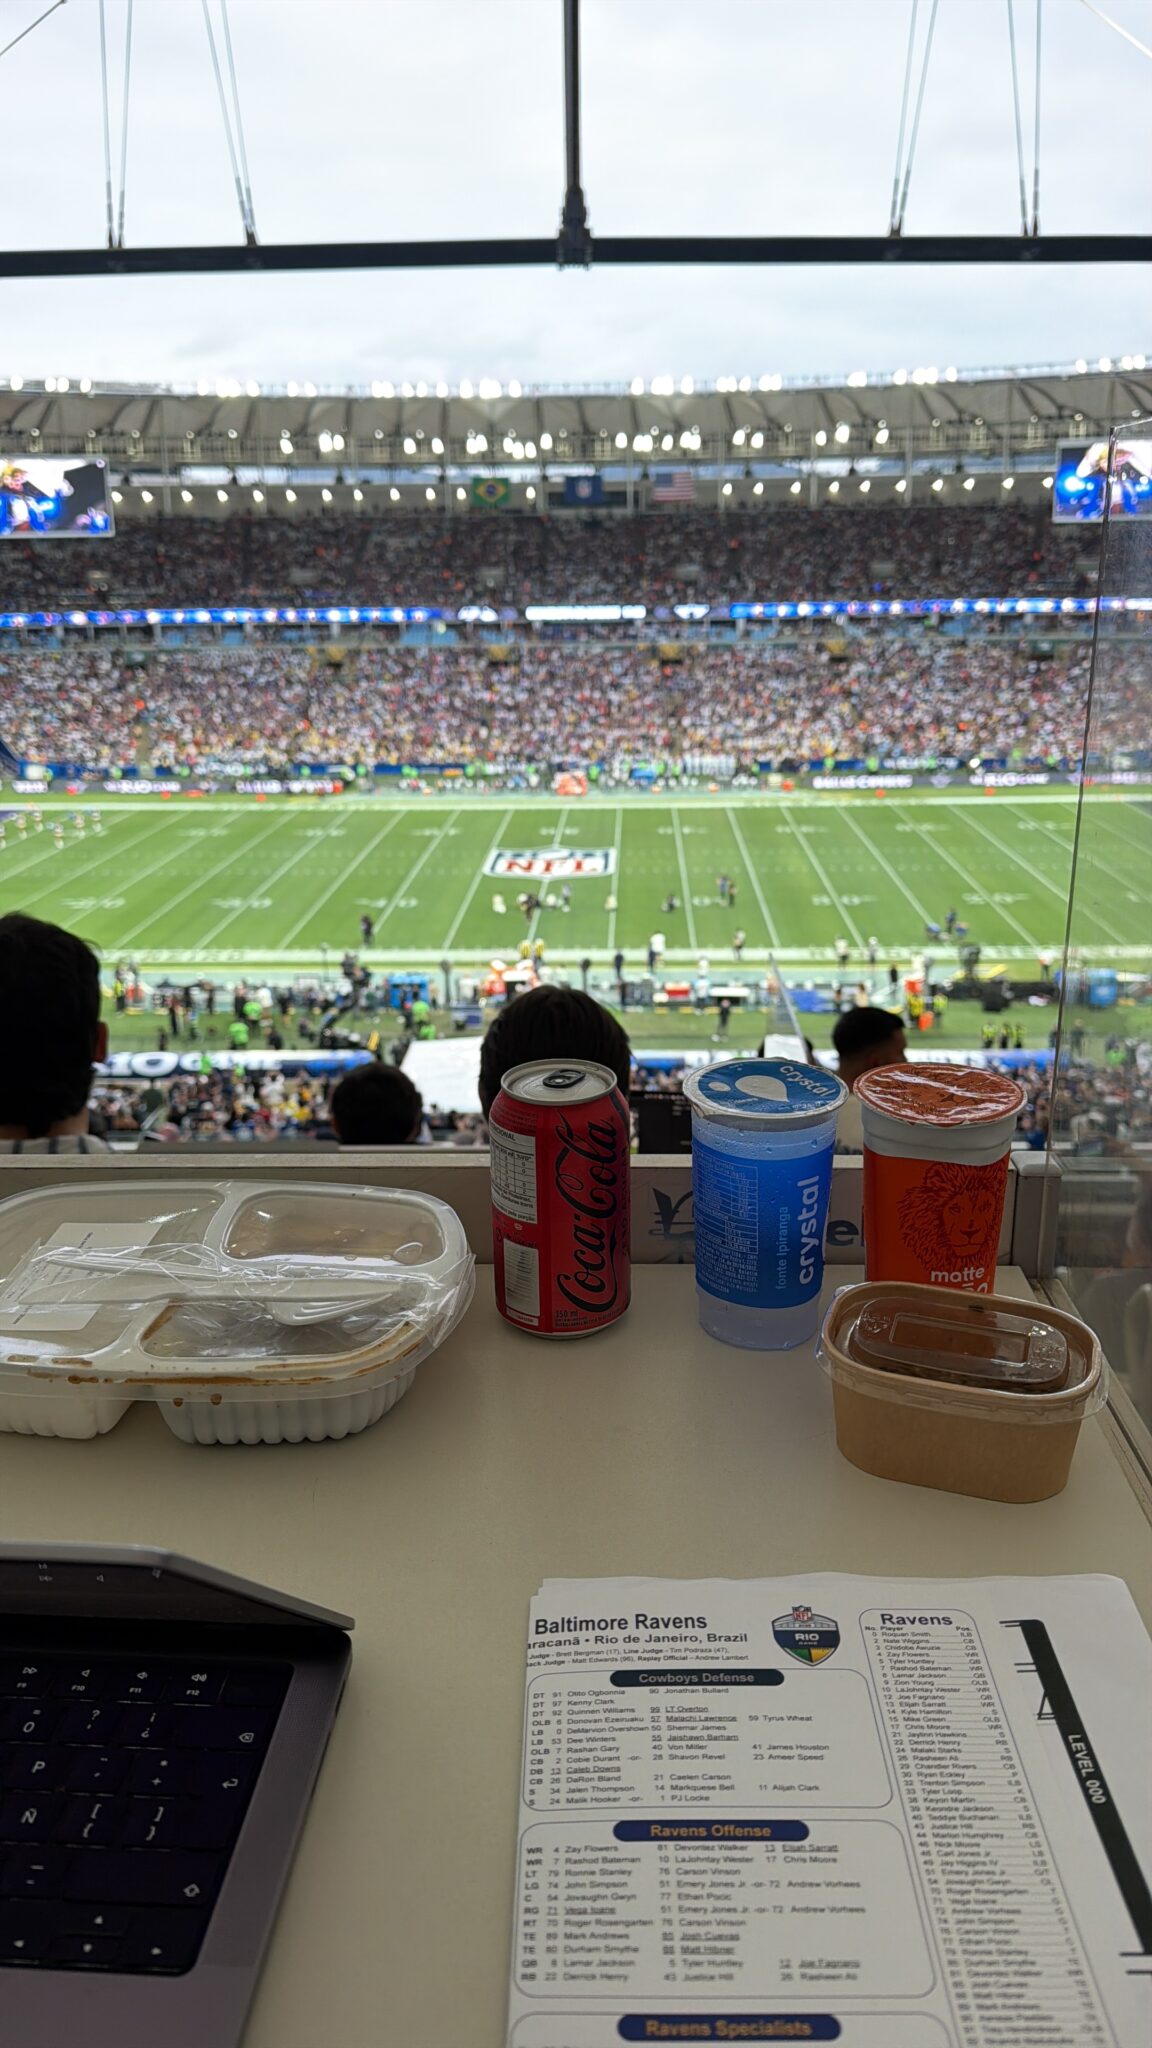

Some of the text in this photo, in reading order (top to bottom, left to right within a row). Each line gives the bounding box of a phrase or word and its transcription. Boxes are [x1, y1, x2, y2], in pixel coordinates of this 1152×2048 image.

[780, 1065, 835, 1096] crystal
[556, 1110, 617, 1313] Coca-Cola
[797, 1176, 819, 1284] crystal
[776, 1207, 790, 1289] fonte Ipiranga
[931, 1267, 984, 1282] matte
[535, 1613, 708, 1635] Baltimore Ravens
[881, 1613, 952, 1625] Ravens
[595, 1635, 618, 1644] Rio
[623, 1635, 640, 1643] de
[645, 1633, 702, 1643] Janeiro,
[707, 1633, 747, 1642] Brazil
[639, 1673, 754, 1684] Cowboys Defense
[23, 1722, 35, 1732] 0
[32, 1761, 45, 1773] P
[1068, 1735, 1106, 1803] LEVEL 000
[21, 1808, 37, 1824] Ñ
[651, 1824, 772, 1836] Ravens Offense
[646, 2019, 812, 2038] Ravens Specialists
